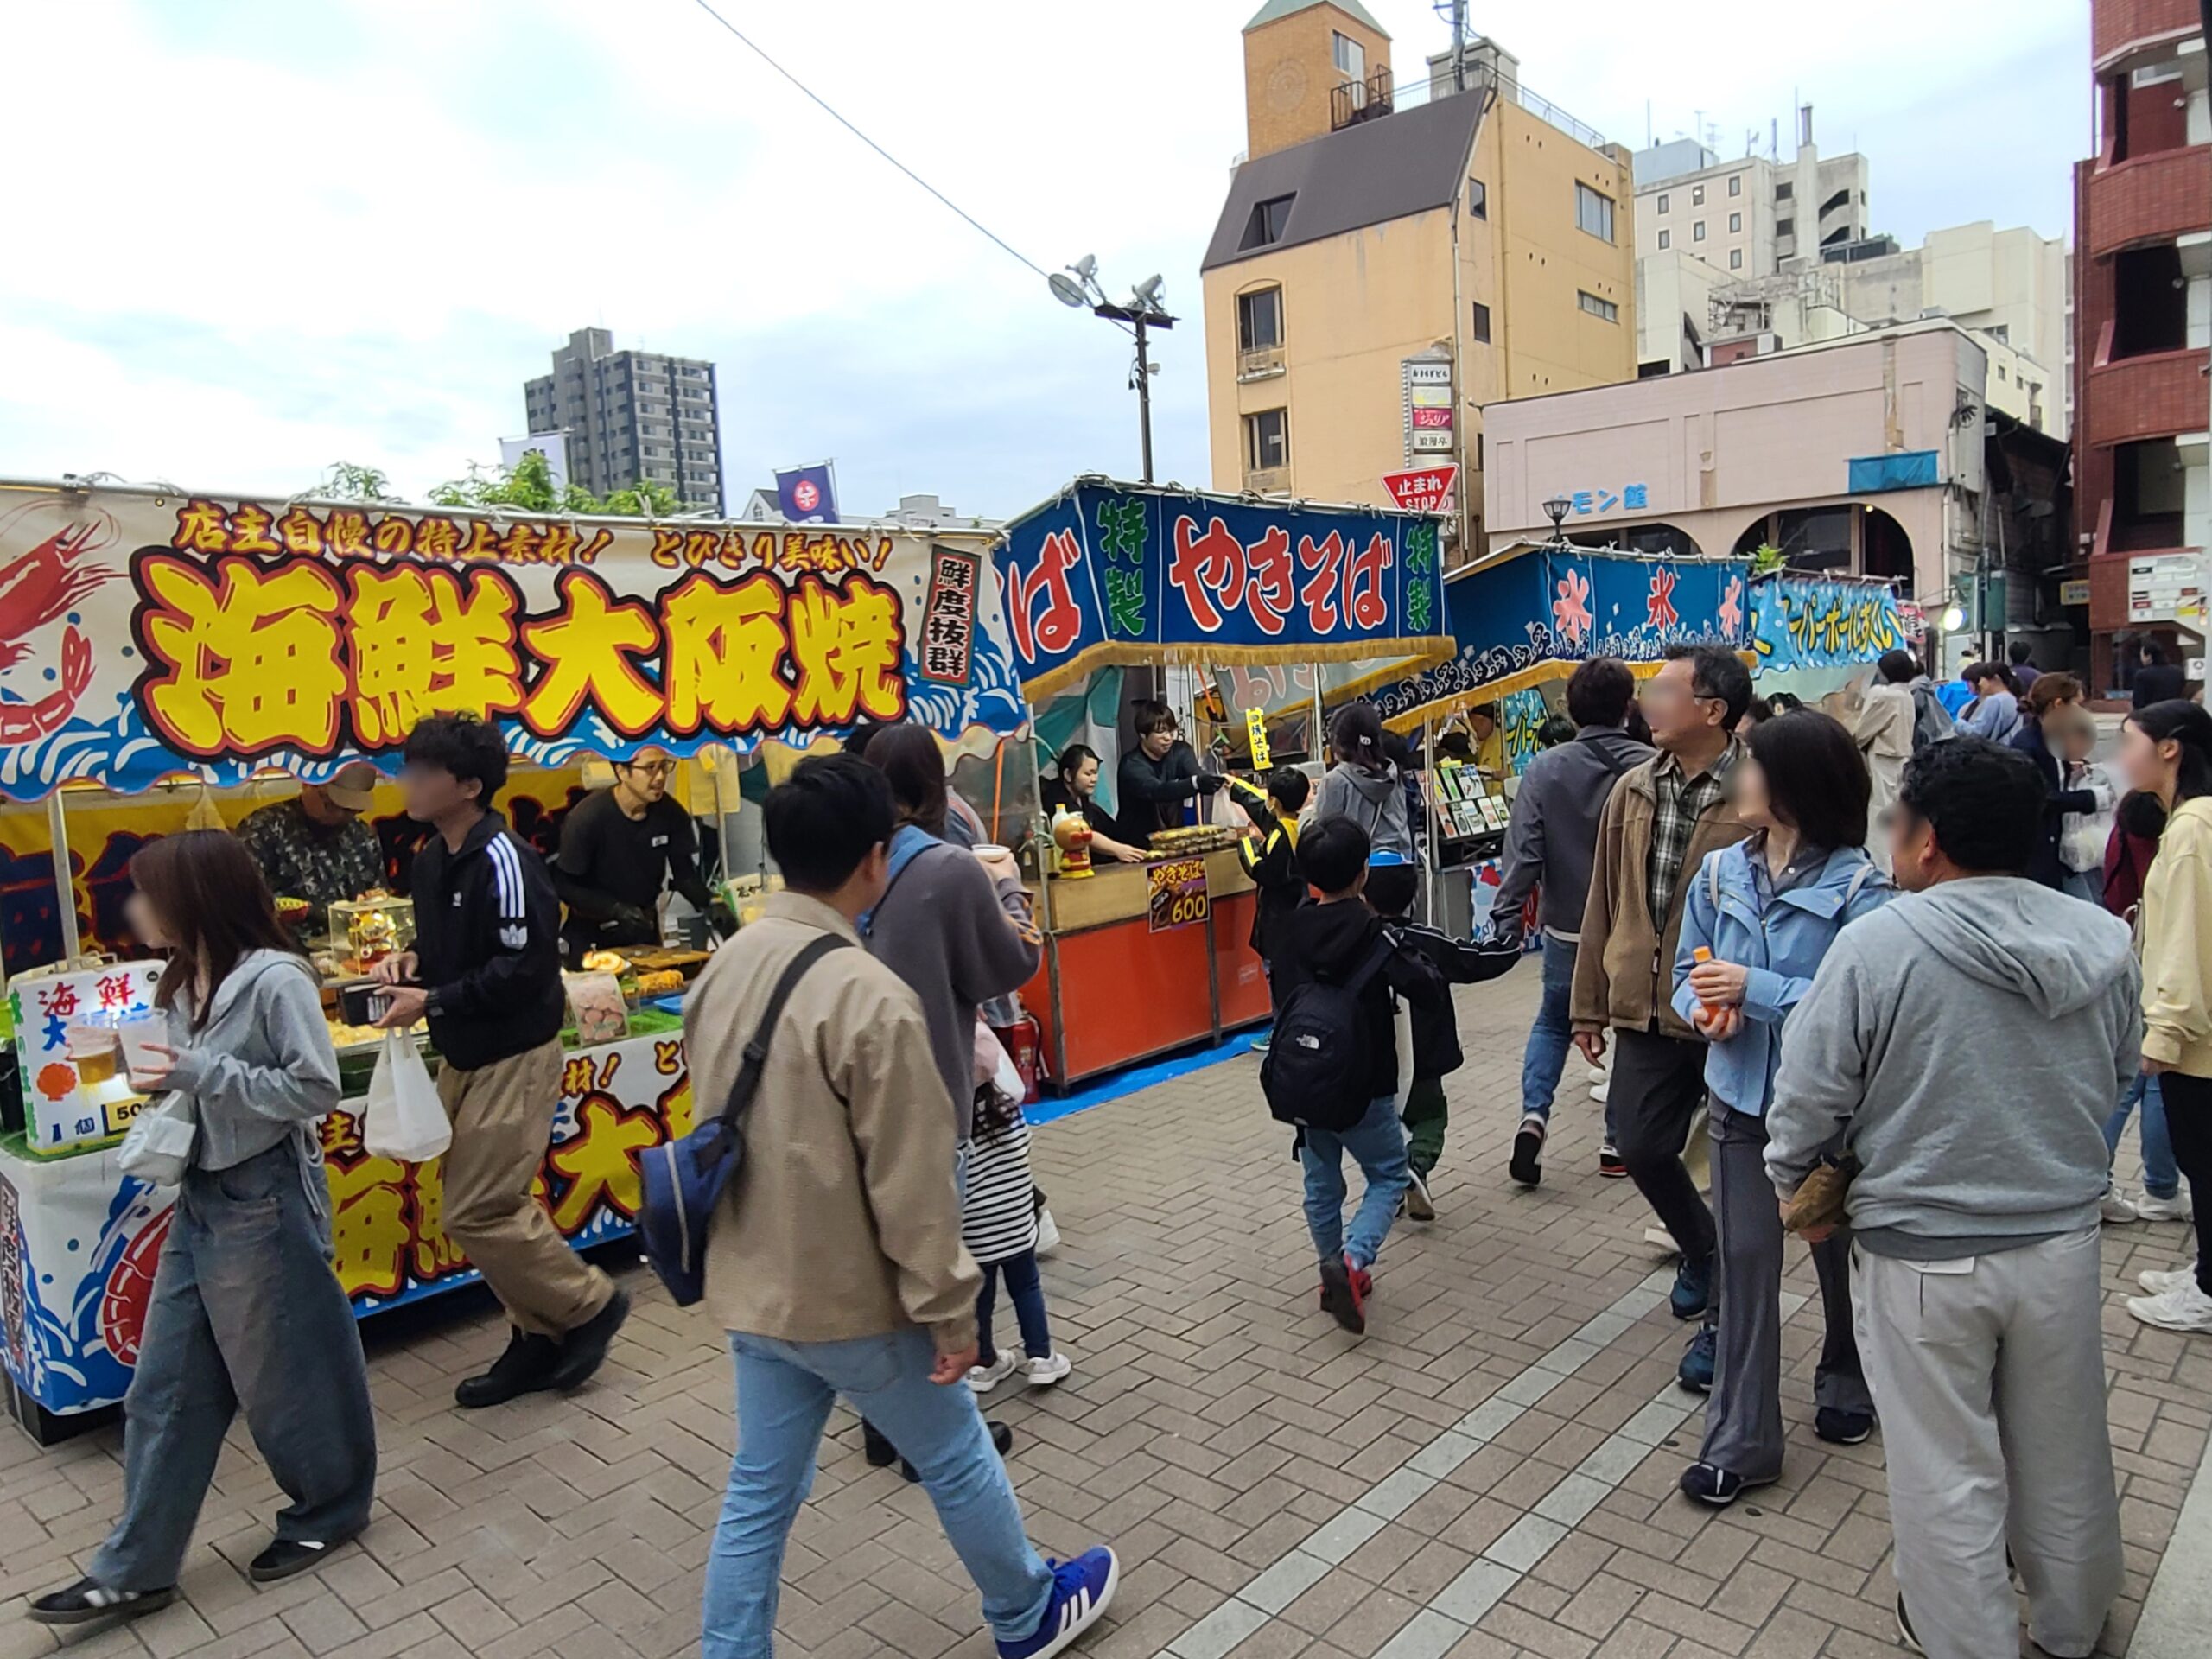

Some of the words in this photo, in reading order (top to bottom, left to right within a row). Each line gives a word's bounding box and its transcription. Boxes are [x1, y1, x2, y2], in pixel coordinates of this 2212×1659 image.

[1397, 475, 1443, 496] 止まれ
[1405, 496, 1437, 510] STOP
[1559, 484, 1648, 517] モン館
[173, 499, 620, 566] 店主自慢の特上素材！
[651, 529, 893, 572] とびきり美味い！
[1096, 496, 1149, 637] 特製
[994, 526, 1082, 665] ば
[1168, 514, 1393, 636] やきそば
[1405, 521, 1436, 632] 特製
[1553, 568, 1592, 641] 氷
[1647, 564, 1678, 631] 氷
[926, 556, 974, 679] 鮮度抜群
[1781, 591, 1903, 657] ーパーボールすくい
[136, 550, 904, 758] 海鮮大阪焼
[1152, 860, 1202, 887] やきそば
[1172, 894, 1206, 924] 600
[38, 973, 135, 1018] 海鮮
[117, 1103, 143, 1121] 50
